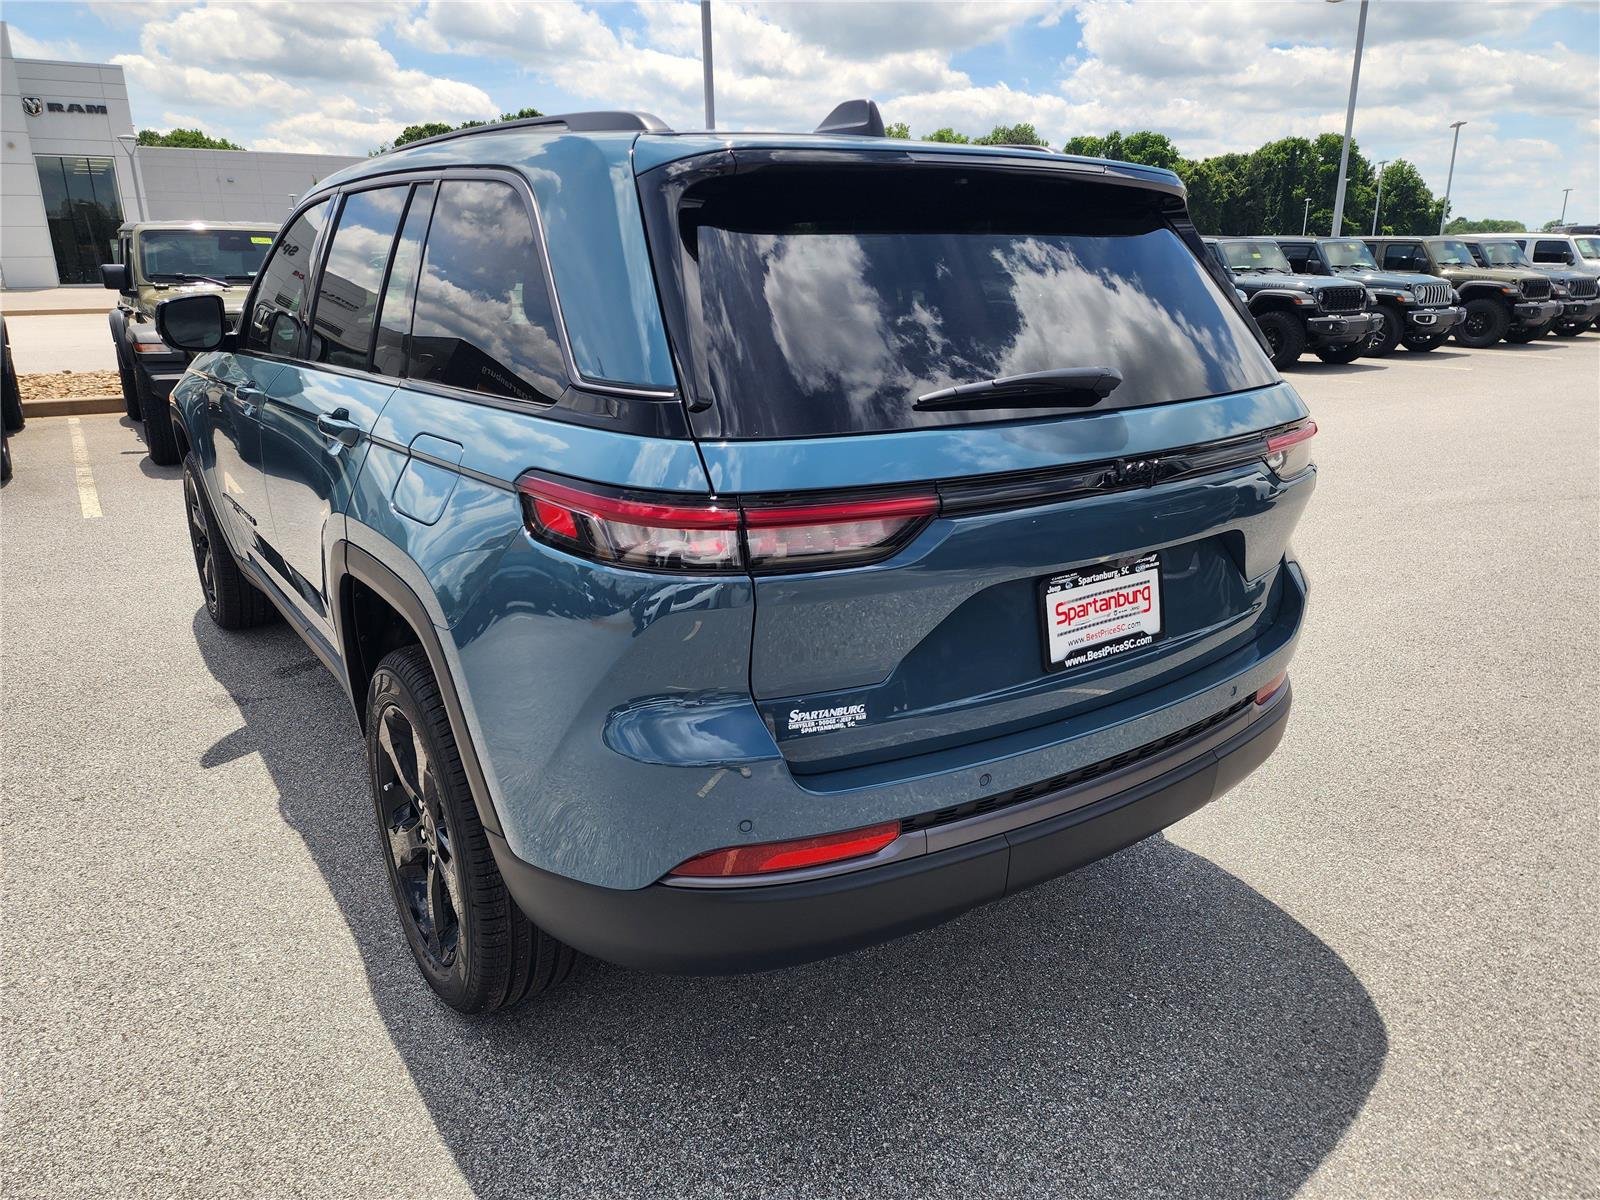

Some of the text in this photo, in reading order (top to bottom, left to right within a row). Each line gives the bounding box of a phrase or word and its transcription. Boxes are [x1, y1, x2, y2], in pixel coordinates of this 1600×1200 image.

[46, 102, 108, 115] RAM
[1078, 569, 1120, 586] Spartanburg,
[1121, 566, 1129, 575] SC
[1055, 585, 1151, 626] Spartanburg
[1067, 620, 1141, 647] www.BestPriceSC.com
[1064, 635, 1153, 668] www.BestPriceSC.com
[788, 704, 865, 723] SPARTANBURG
[788, 721, 815, 730] CHRYSLER
[855, 713, 867, 721] RAM
[801, 720, 856, 734] SPARTANBURG, SC
